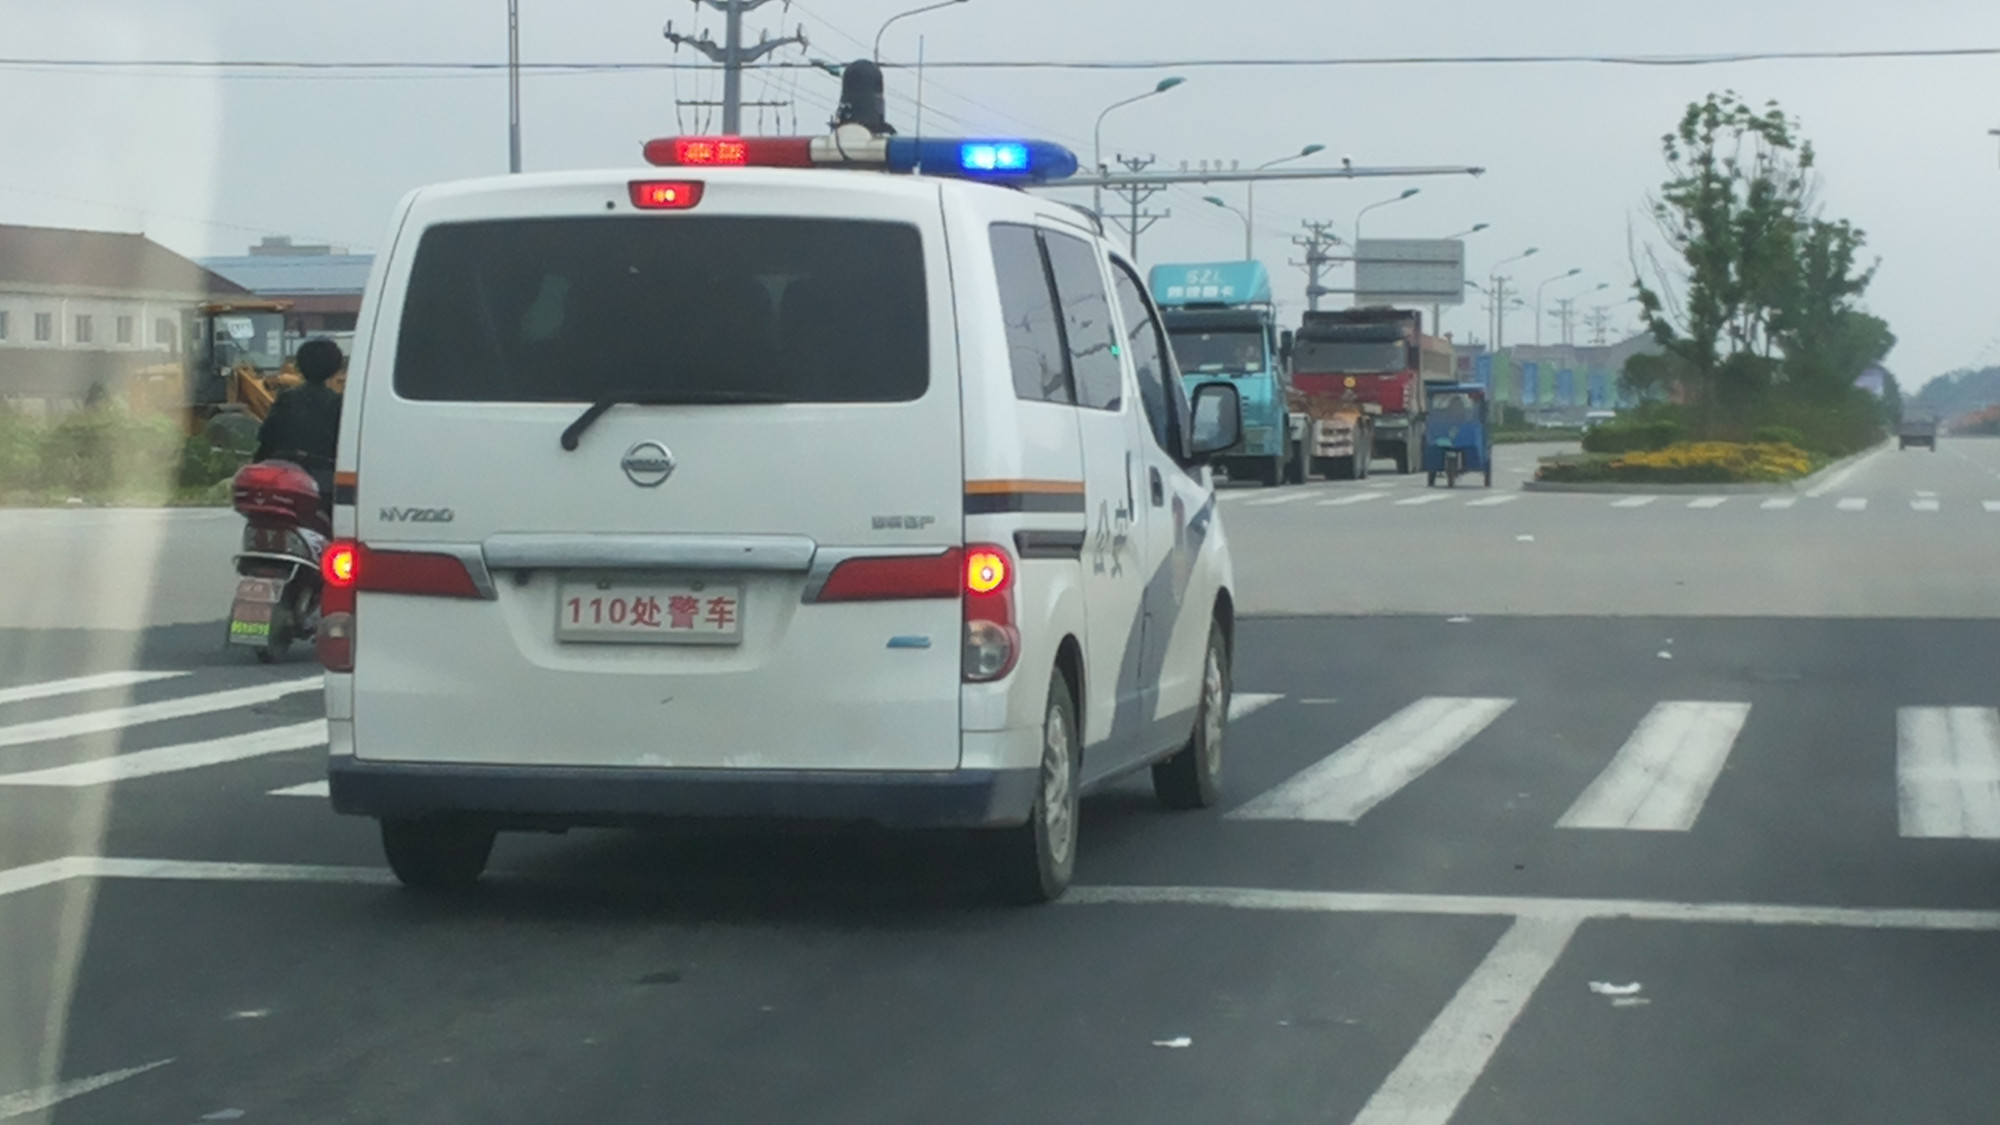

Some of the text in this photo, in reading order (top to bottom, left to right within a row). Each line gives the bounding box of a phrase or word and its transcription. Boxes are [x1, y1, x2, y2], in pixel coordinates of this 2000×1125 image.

[1092, 499, 1129, 578] 公安
[567, 595, 737, 630] 110处警车
